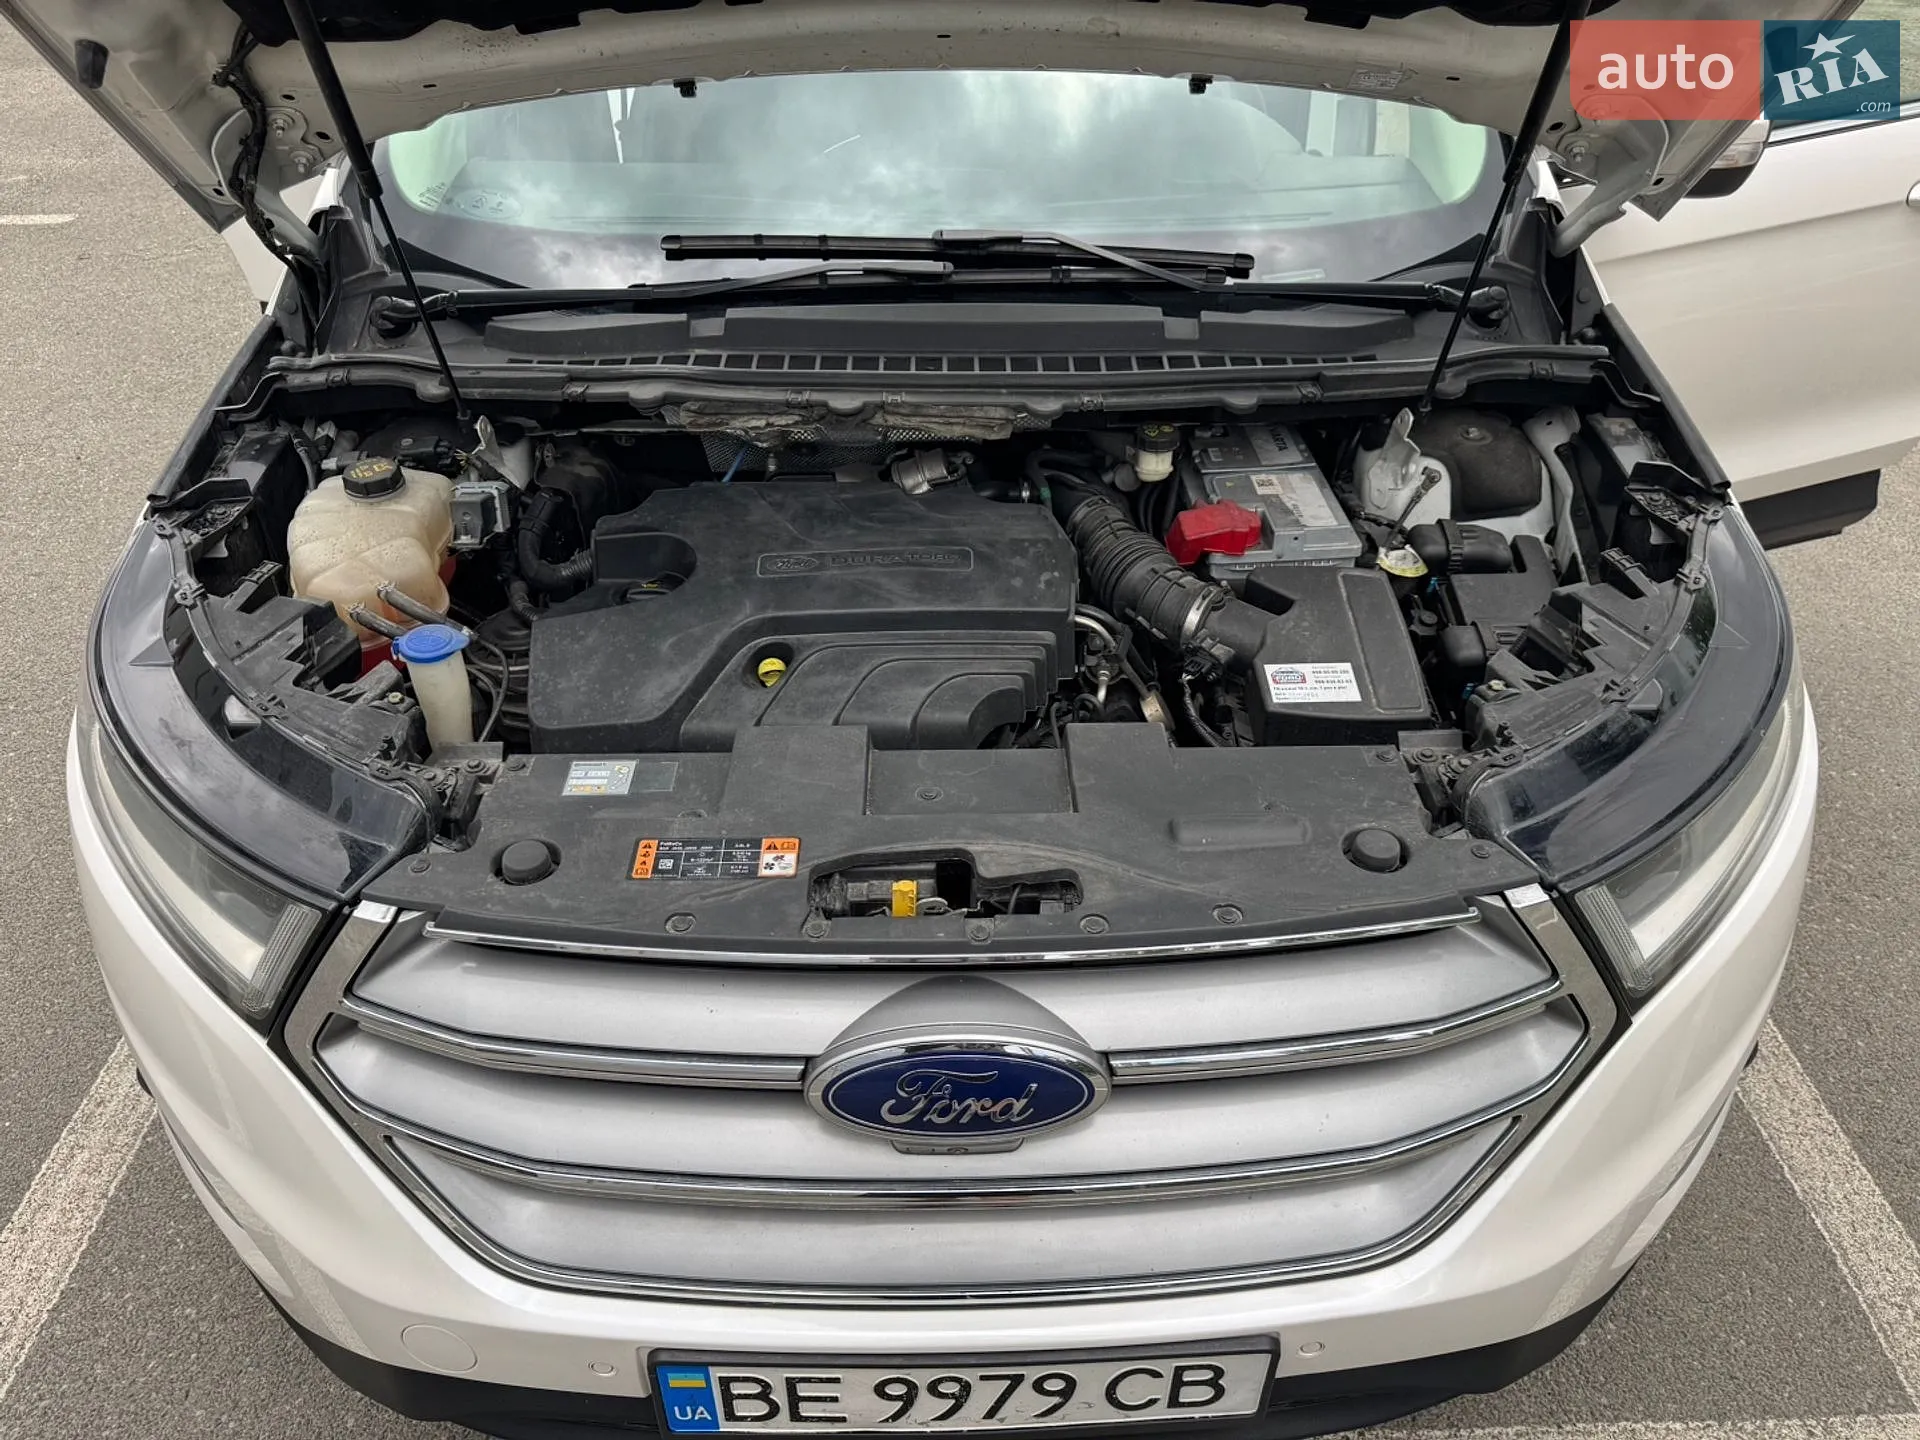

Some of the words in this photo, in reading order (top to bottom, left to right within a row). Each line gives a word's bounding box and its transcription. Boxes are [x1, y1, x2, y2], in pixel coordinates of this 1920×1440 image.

[880, 1069, 1039, 1124] Ford
[674, 1404, 713, 1423] UA
[716, 1374, 848, 1424] BE
[873, 1371, 1078, 1422] 9979
[1104, 1362, 1227, 1411] CB
